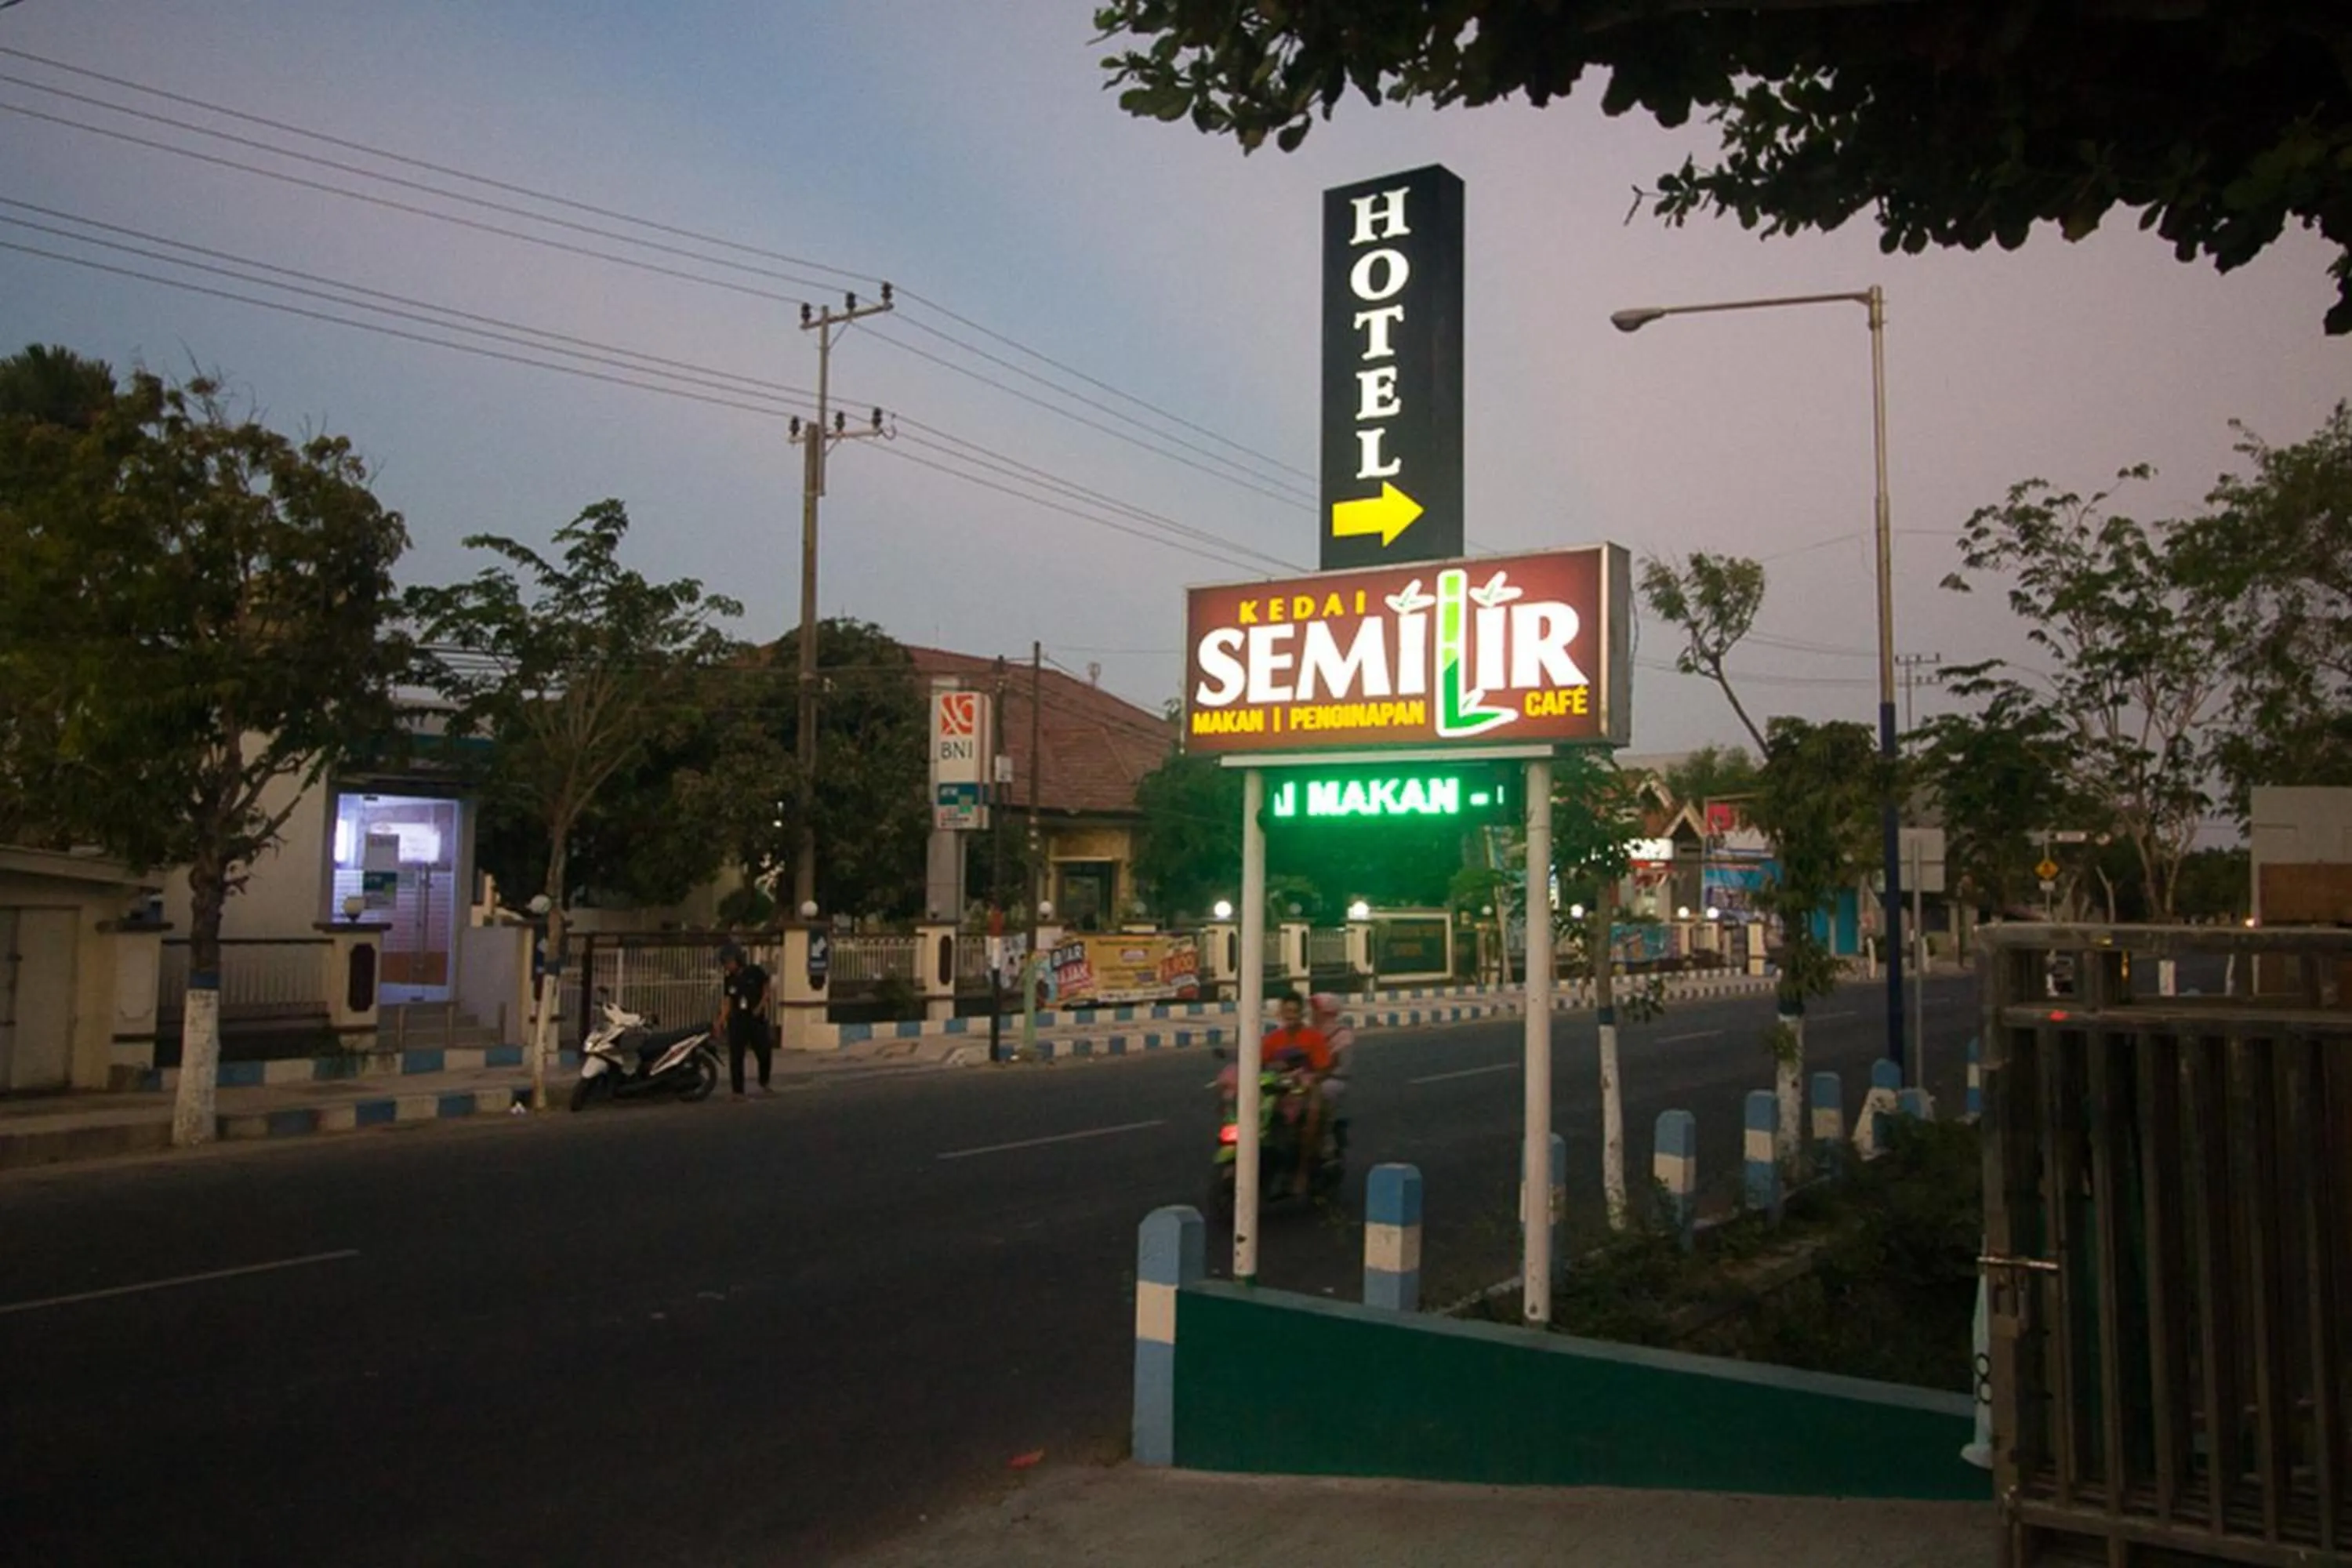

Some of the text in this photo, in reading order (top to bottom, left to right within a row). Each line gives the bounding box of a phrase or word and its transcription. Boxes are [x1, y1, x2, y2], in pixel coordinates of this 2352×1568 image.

[1350, 187, 1410, 479] HOTEL
[1239, 590, 1367, 625] KEDAI
[1193, 708, 1265, 734] MAKAN
[1289, 700, 1426, 731] PENGINAPAN
[1524, 684, 1588, 717] CAFÉ
[942, 742, 973, 759] BNI
[1307, 778, 1459, 816] MAKAN
